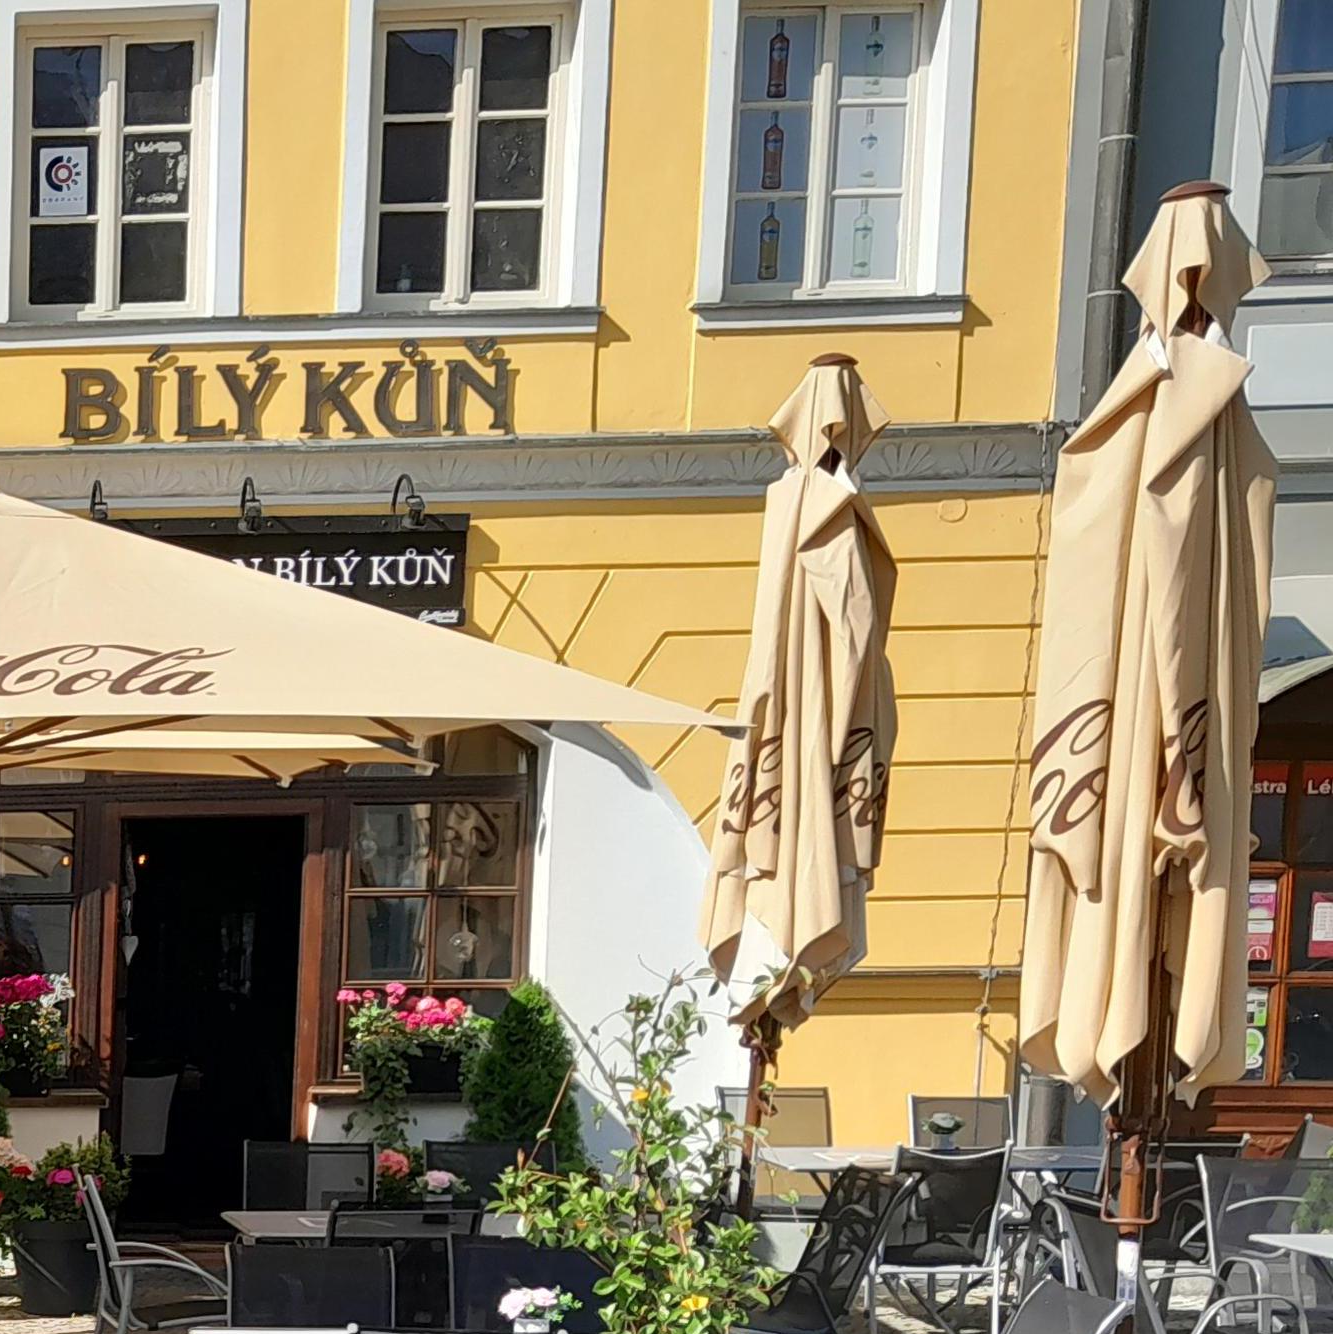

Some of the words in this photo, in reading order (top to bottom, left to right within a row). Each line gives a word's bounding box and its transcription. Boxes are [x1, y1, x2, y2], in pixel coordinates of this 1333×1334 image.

[59, 344, 277, 441] BÍLÝ
[300, 337, 512, 438] KŮŇ
[273, 549, 362, 587] BÍLÝ
[369, 547, 456, 585] KŮŇ
[1252, 780, 1287, 794] stra
